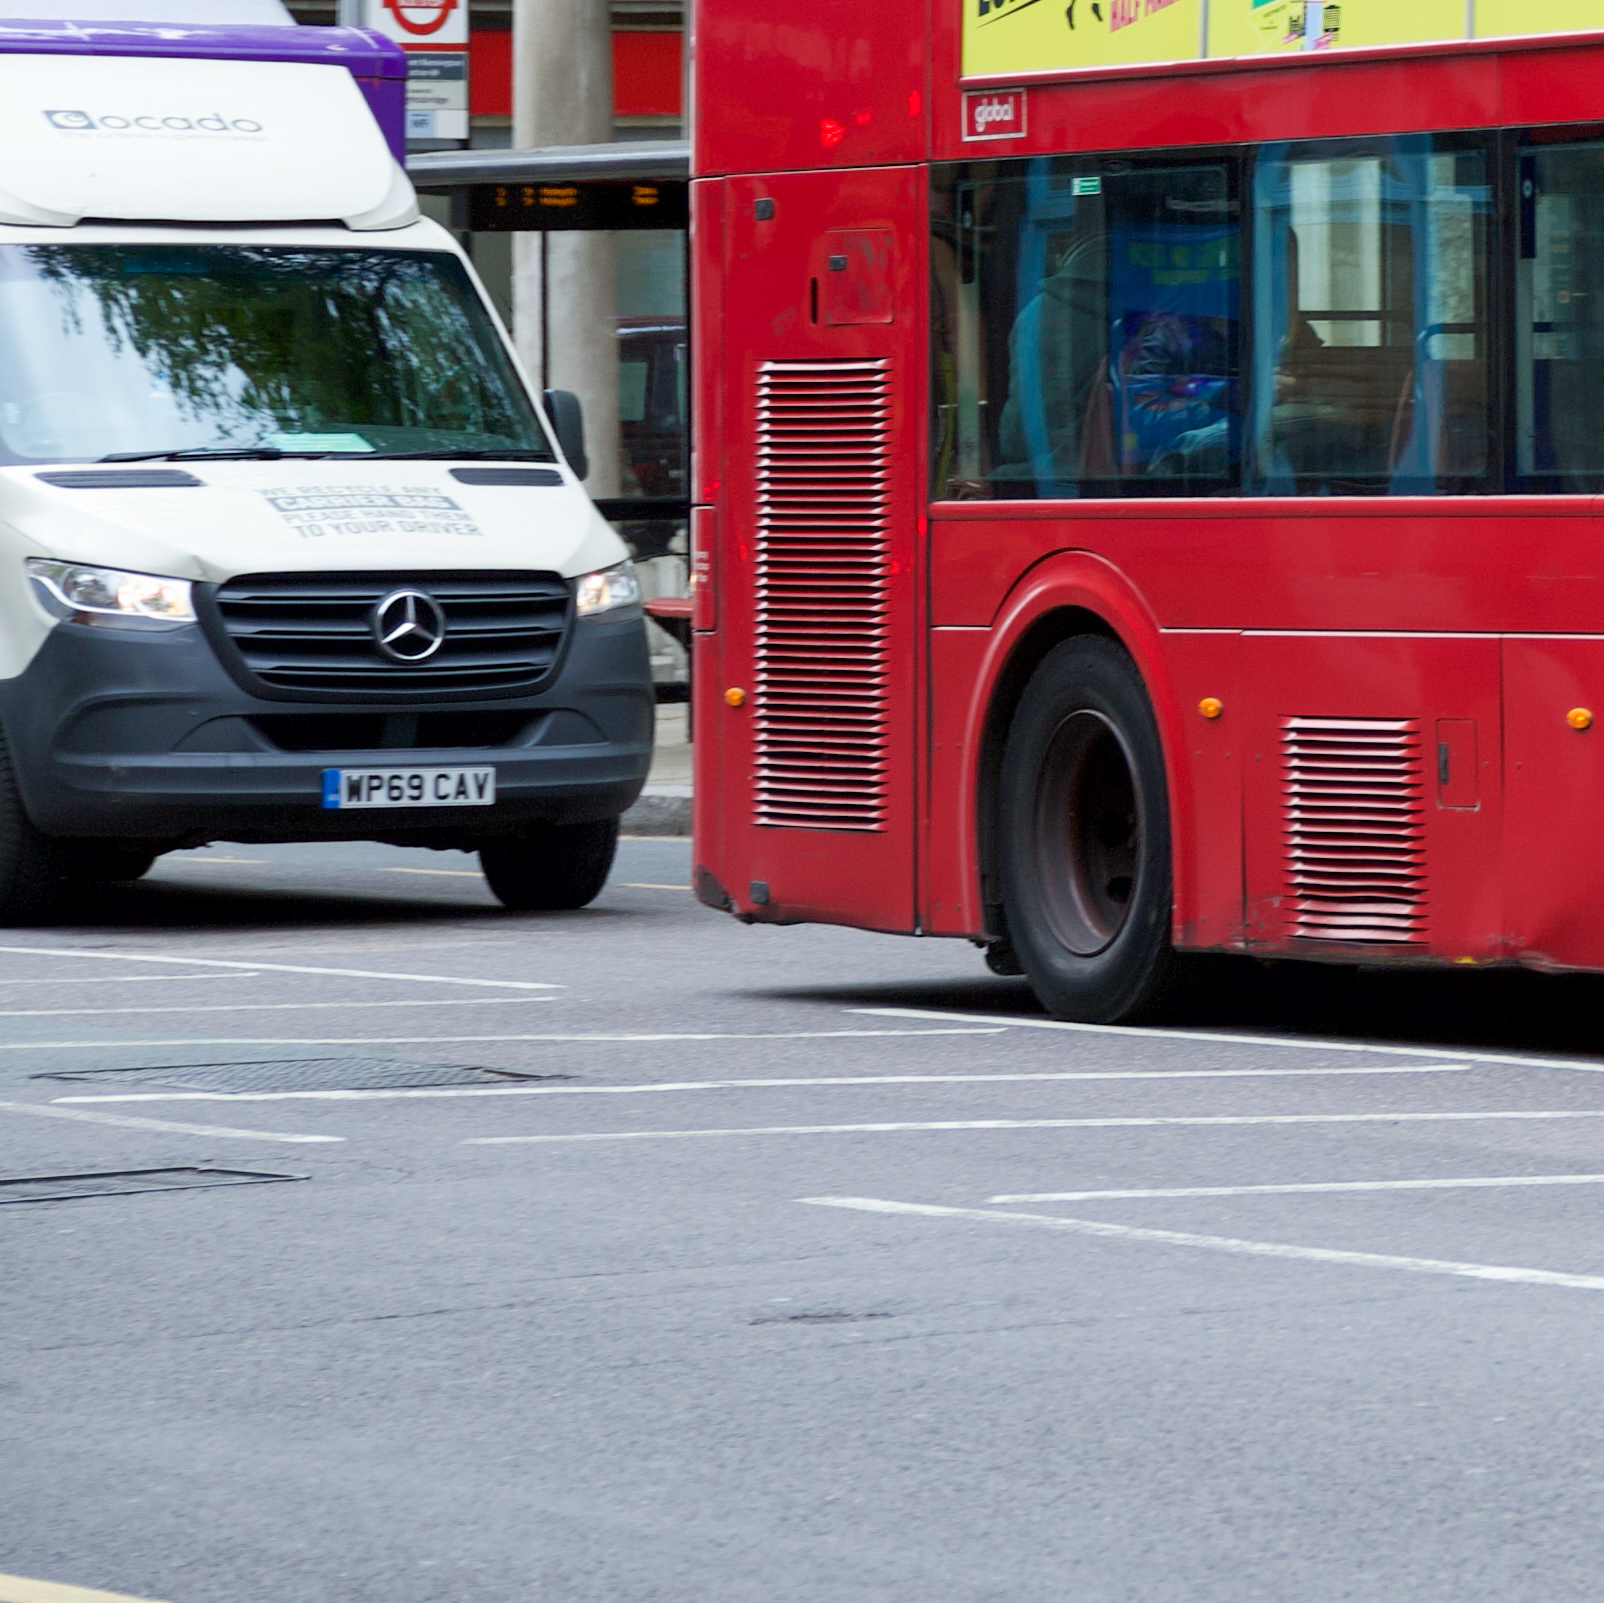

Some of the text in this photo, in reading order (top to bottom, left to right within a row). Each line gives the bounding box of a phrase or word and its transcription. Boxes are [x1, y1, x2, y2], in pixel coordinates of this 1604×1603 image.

[99, 112, 263, 133] ocado
[974, 96, 1014, 132] global
[273, 495, 395, 511] CARRIER
[291, 518, 484, 538] TO YOUR DRIVER
[347, 772, 490, 802] WP69 CAV
